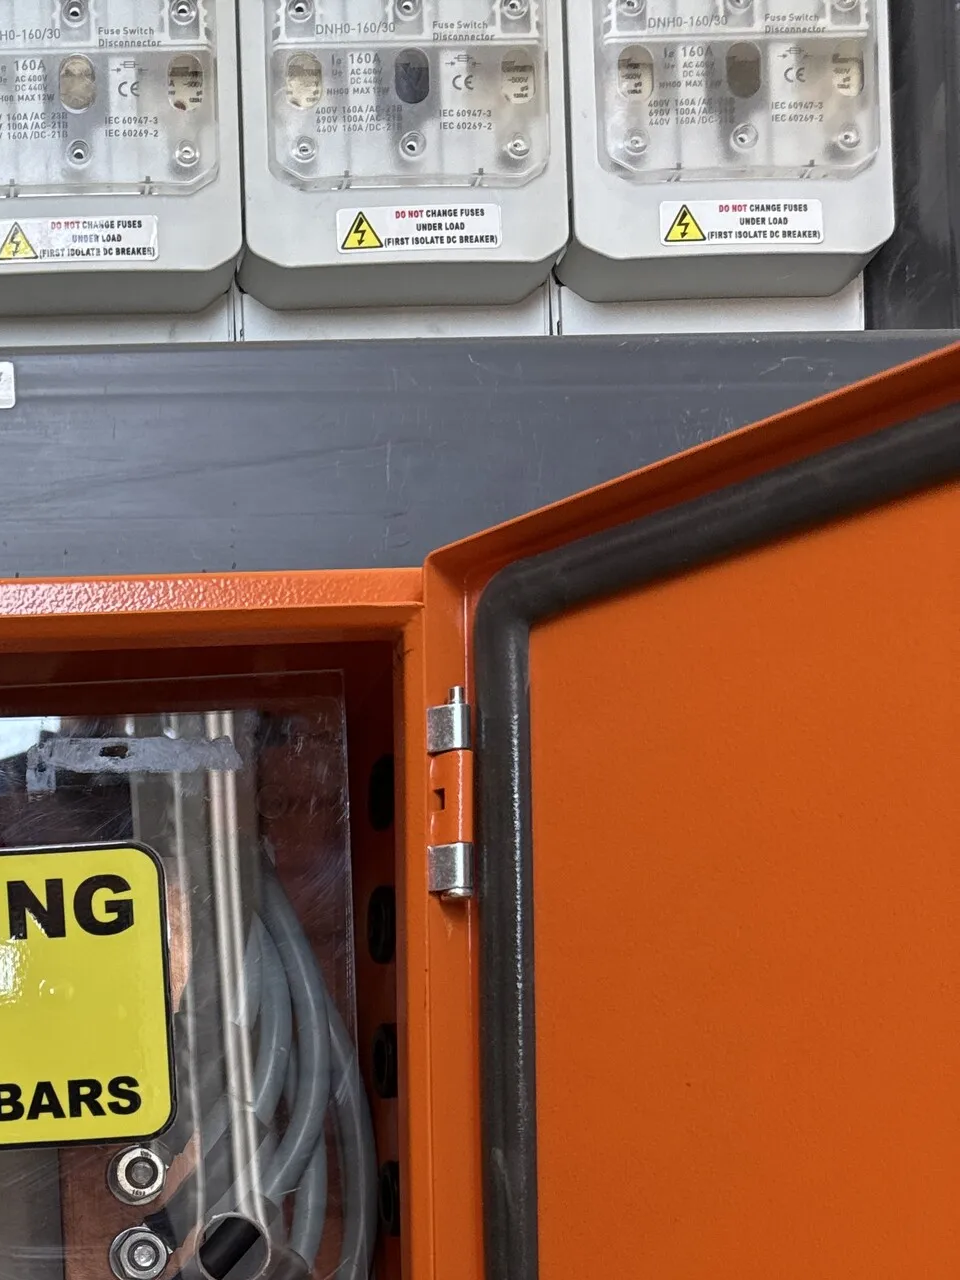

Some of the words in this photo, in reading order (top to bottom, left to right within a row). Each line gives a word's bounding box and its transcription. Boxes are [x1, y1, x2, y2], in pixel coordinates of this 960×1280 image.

[648, 16, 727, 28] DNH0-160/30
[765, 14, 786, 22] Fuse
[315, 23, 395, 34] DNH0-160/30
[433, 21, 454, 29] Fuse
[457, 21, 488, 29] Switch
[765, 25, 826, 33] Disconnector
[98, 27, 120, 35] Fuse
[123, 27, 154, 35] Switch
[433, 33, 495, 41] Disconnector
[99, 39, 162, 47] Disconnector
[682, 47, 712, 57] 160A
[350, 54, 380, 64] 160A
[14, 60, 46, 70] 160A
[316, 115, 337, 123] 690V
[317, 125, 337, 133] 440V
[456, 122, 492, 130] 60269-2
[750, 204, 780, 212] CHANGE
[408, 210, 423, 218] NOT
[426, 209, 457, 217] CHANGE
[82, 221, 114, 229] CHANGE
[768, 217, 788, 225] LOAD
[416, 223, 442, 231] UNDER
[72, 235, 98, 243] UNDER
[102, 234, 121, 242] LOAD
[708, 231, 732, 240] (FIRST
[782, 231, 820, 239] BREAKER)
[384, 238, 409, 247] (FIRST
[412, 237, 444, 245] ISOLATE
[447, 236, 456, 244] DC
[460, 235, 497, 244] BREAKER)
[40, 249, 64, 259] (FIRST
